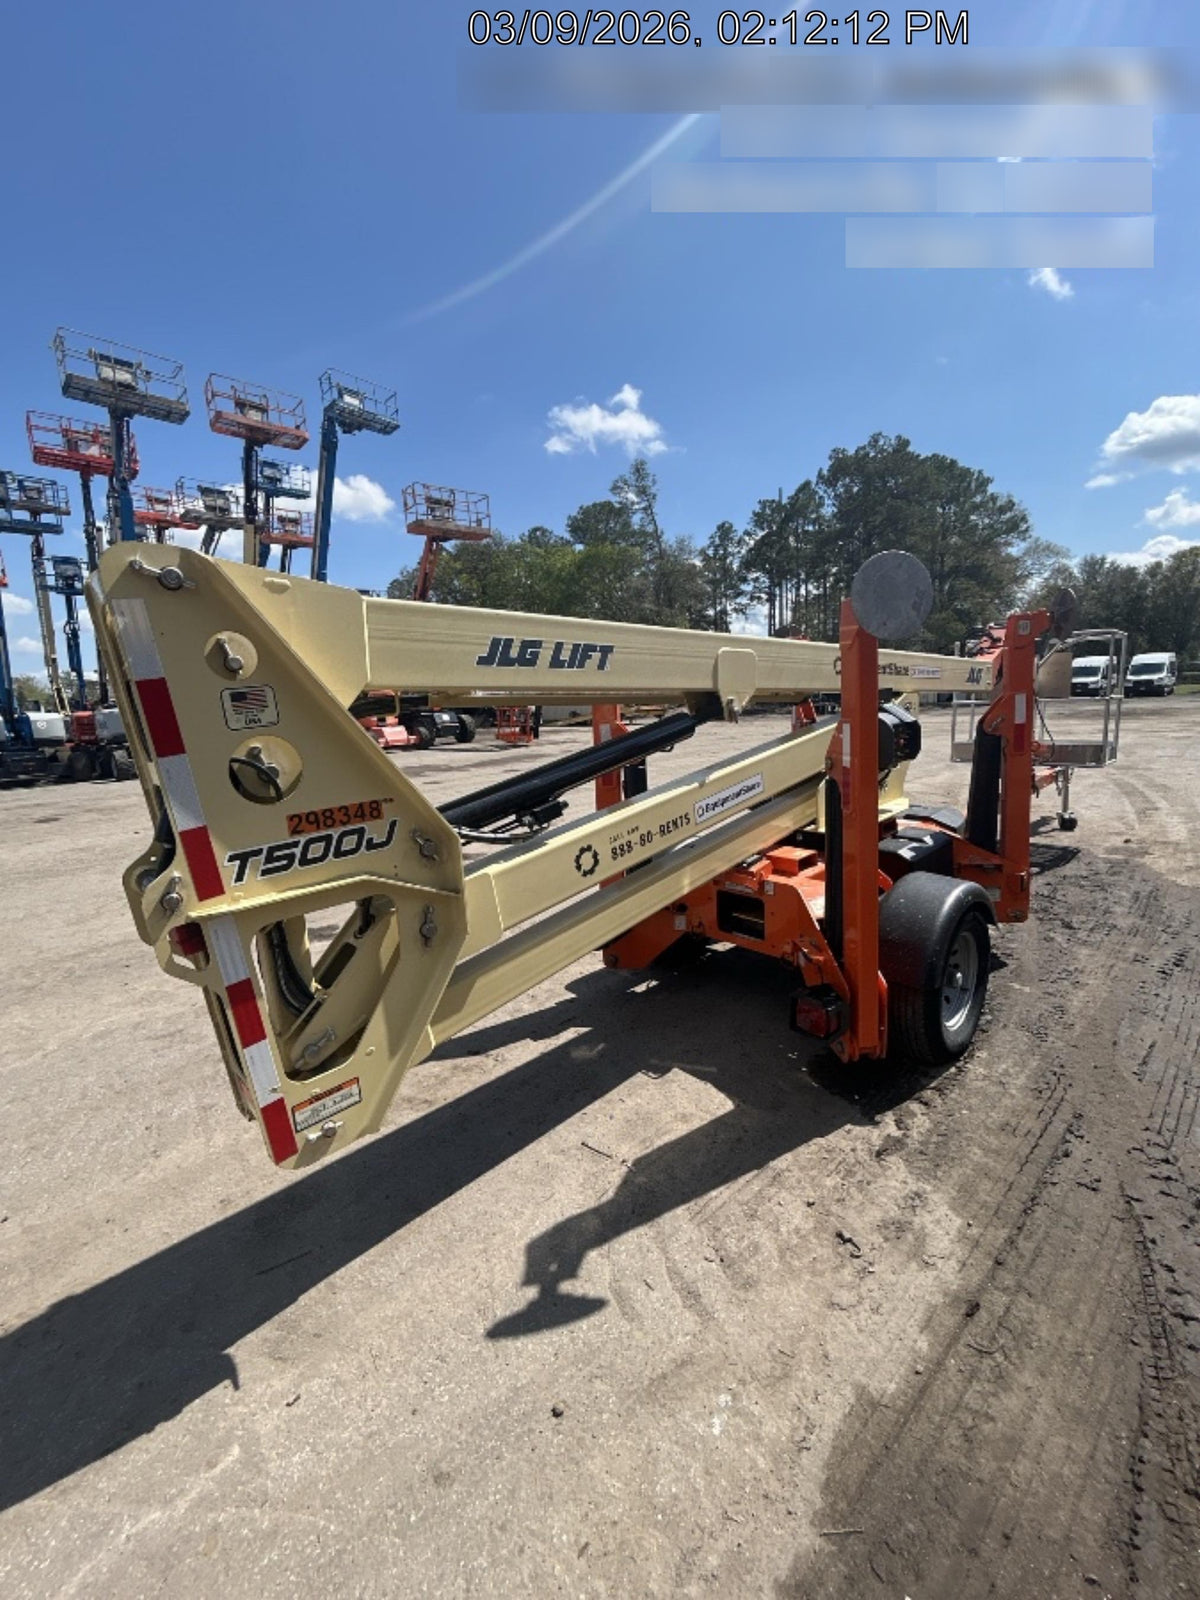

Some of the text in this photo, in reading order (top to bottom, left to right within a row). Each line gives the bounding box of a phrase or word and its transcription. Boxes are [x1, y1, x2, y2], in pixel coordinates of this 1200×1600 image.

[475, 636, 616, 671] JLG LIFT
[289, 799, 383, 836] 298348
[610, 812, 691, 861] 888-80-RENTS
[225, 818, 399, 886] T500J
